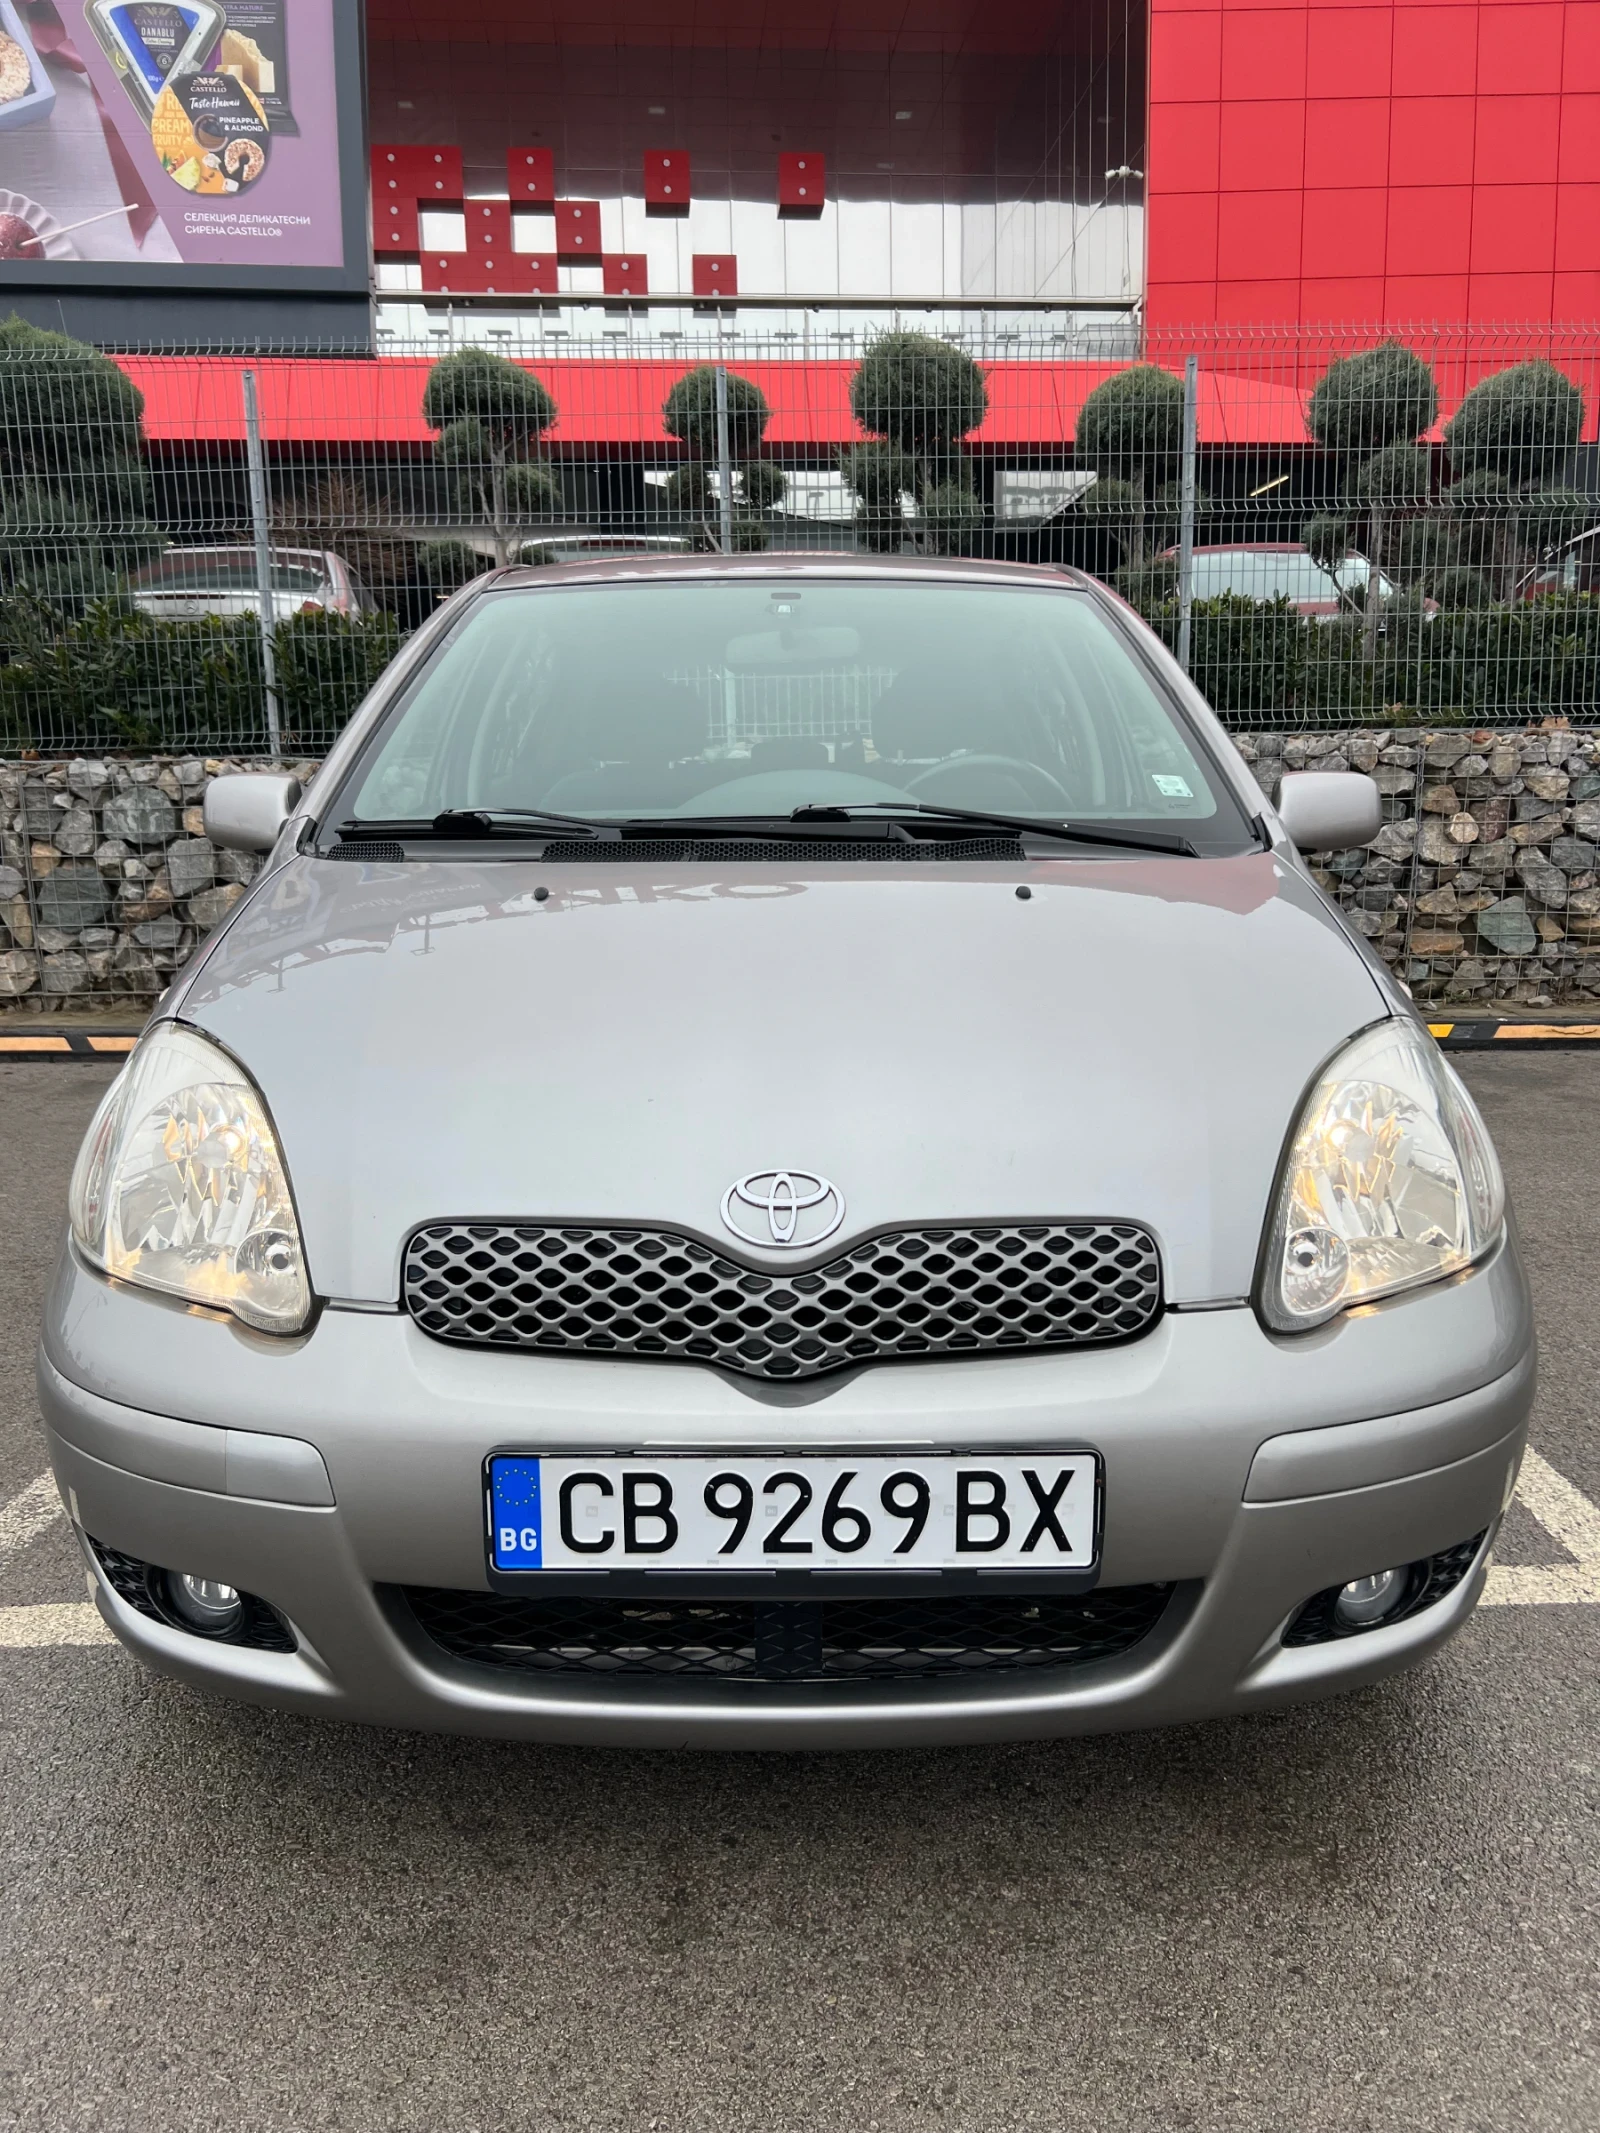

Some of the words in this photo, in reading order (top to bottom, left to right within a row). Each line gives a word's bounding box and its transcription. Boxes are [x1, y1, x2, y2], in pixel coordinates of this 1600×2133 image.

[239, 4, 264, 12] MATURE
[133, 18, 183, 28] CASTELLO
[141, 26, 175, 38] DANABLU
[190, 85, 227, 93] CASTELLO
[211, 96, 241, 109] Hawaii
[219, 116, 260, 124] PINEAPPLE
[230, 125, 264, 133] ALMOND
[183, 212, 237, 224] СЕЛЕКЦИЯ
[238, 214, 311, 225] ДЕЛИКАТЕСНИ
[184, 225, 226, 235] СИРЕНА
[703, 1471, 932, 1554] 9269
[500, 1527, 537, 1552] BG
